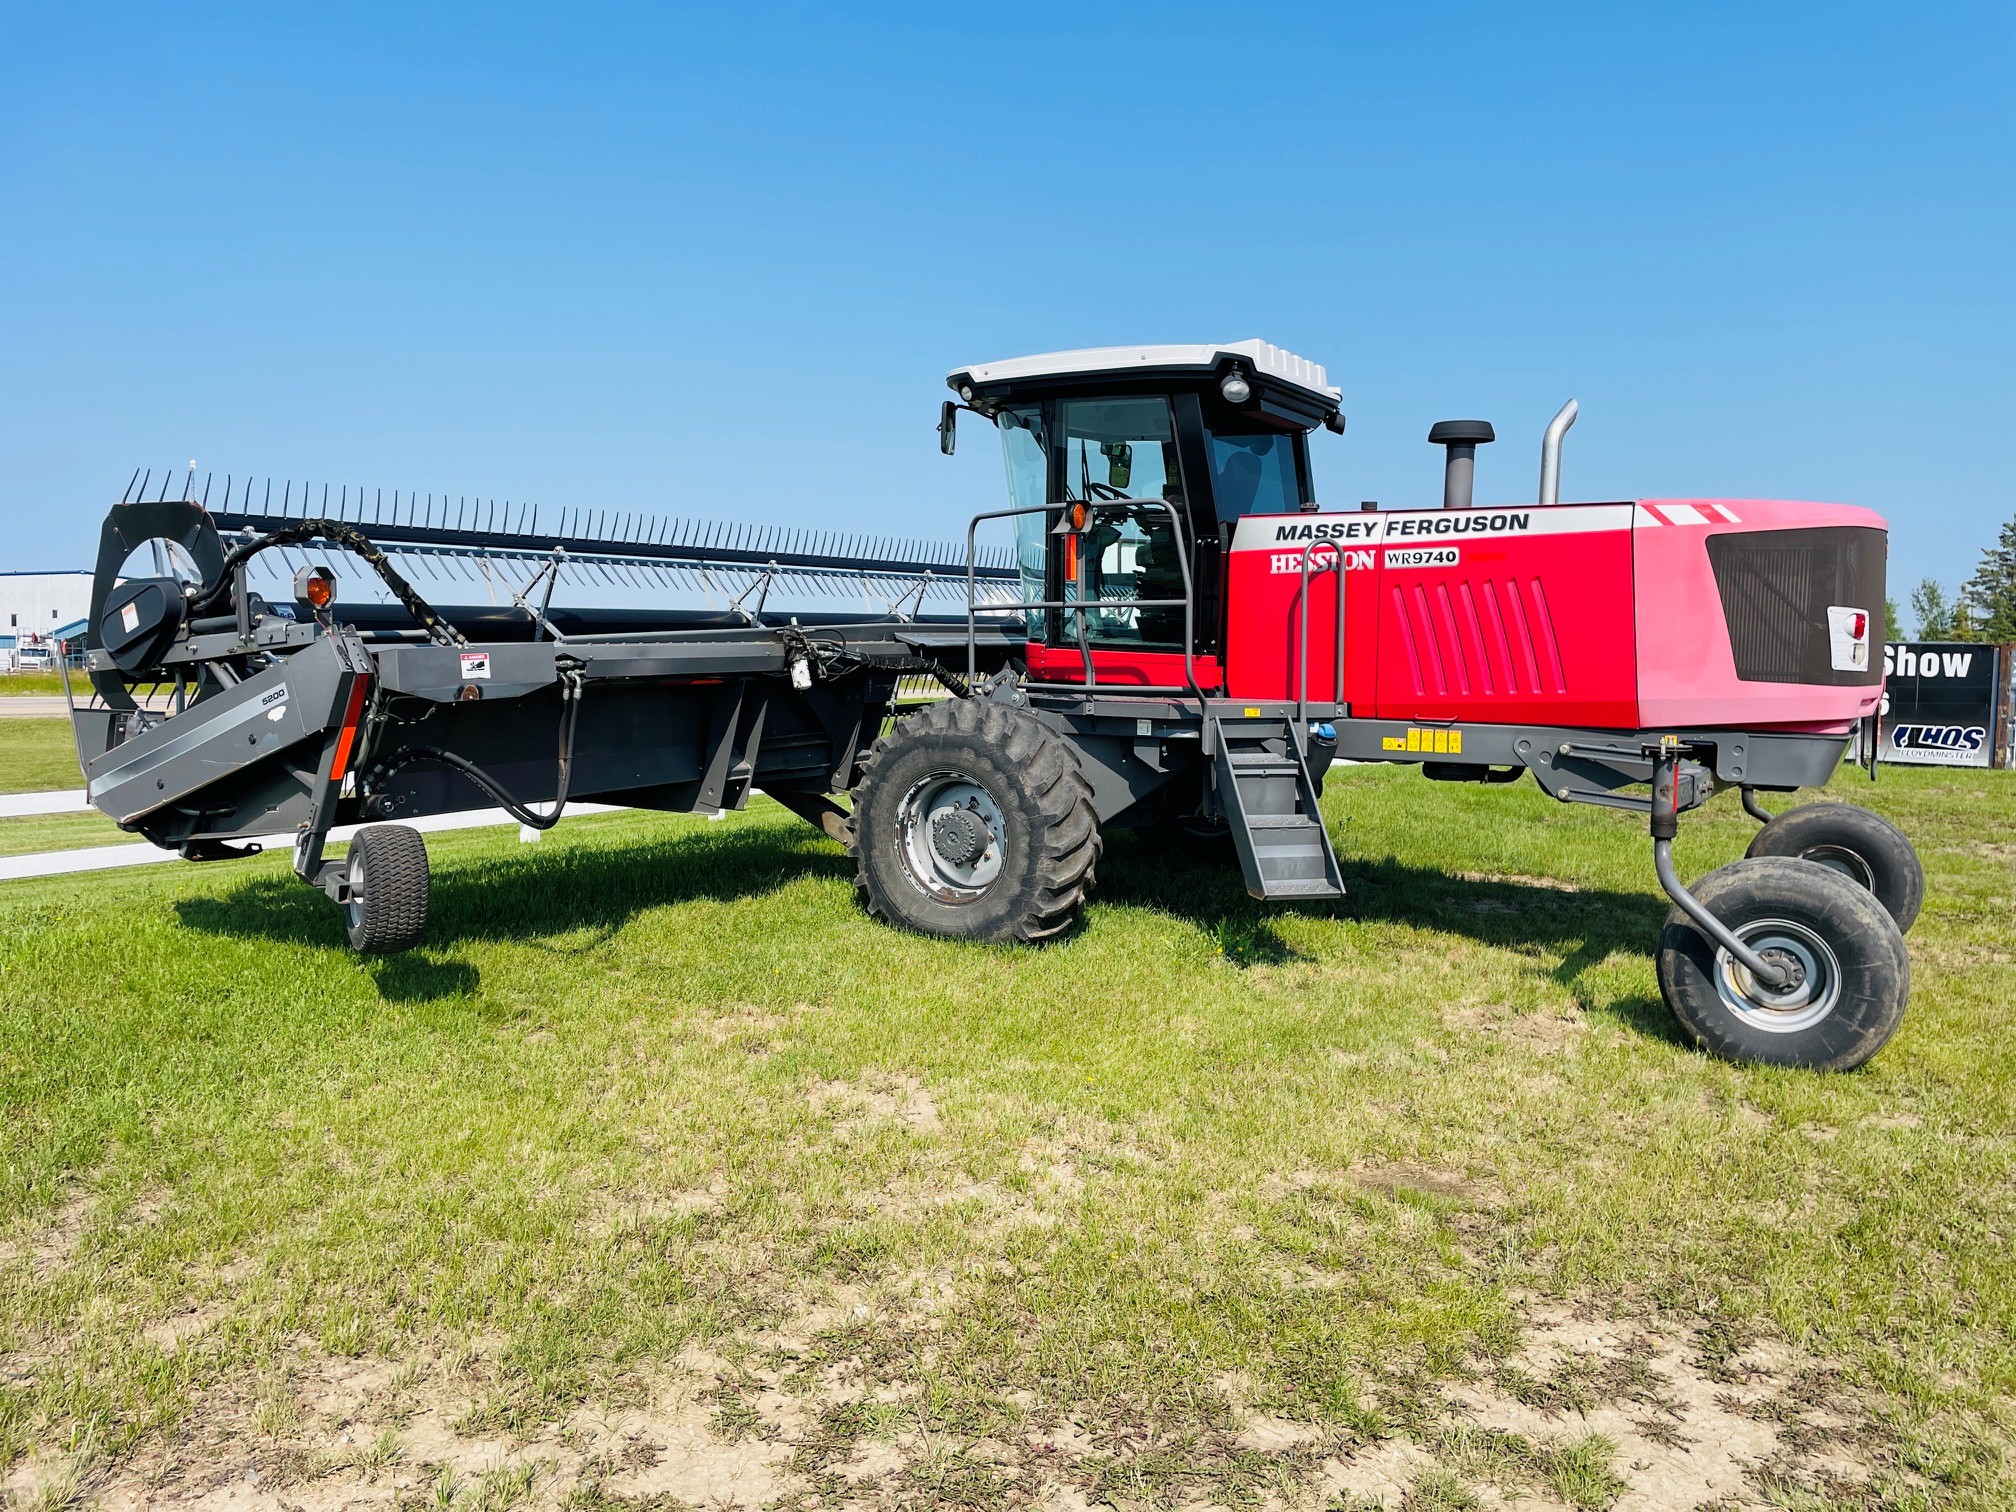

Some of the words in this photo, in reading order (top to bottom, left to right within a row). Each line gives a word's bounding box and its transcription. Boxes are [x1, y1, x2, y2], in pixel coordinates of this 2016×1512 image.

[1275, 521, 1378, 541] MASSEY
[1385, 513, 1530, 536] FERGUSON
[1270, 549, 1377, 575] HESSTON
[1387, 550, 1457, 565] WR9740
[262, 689, 285, 706] 5200
